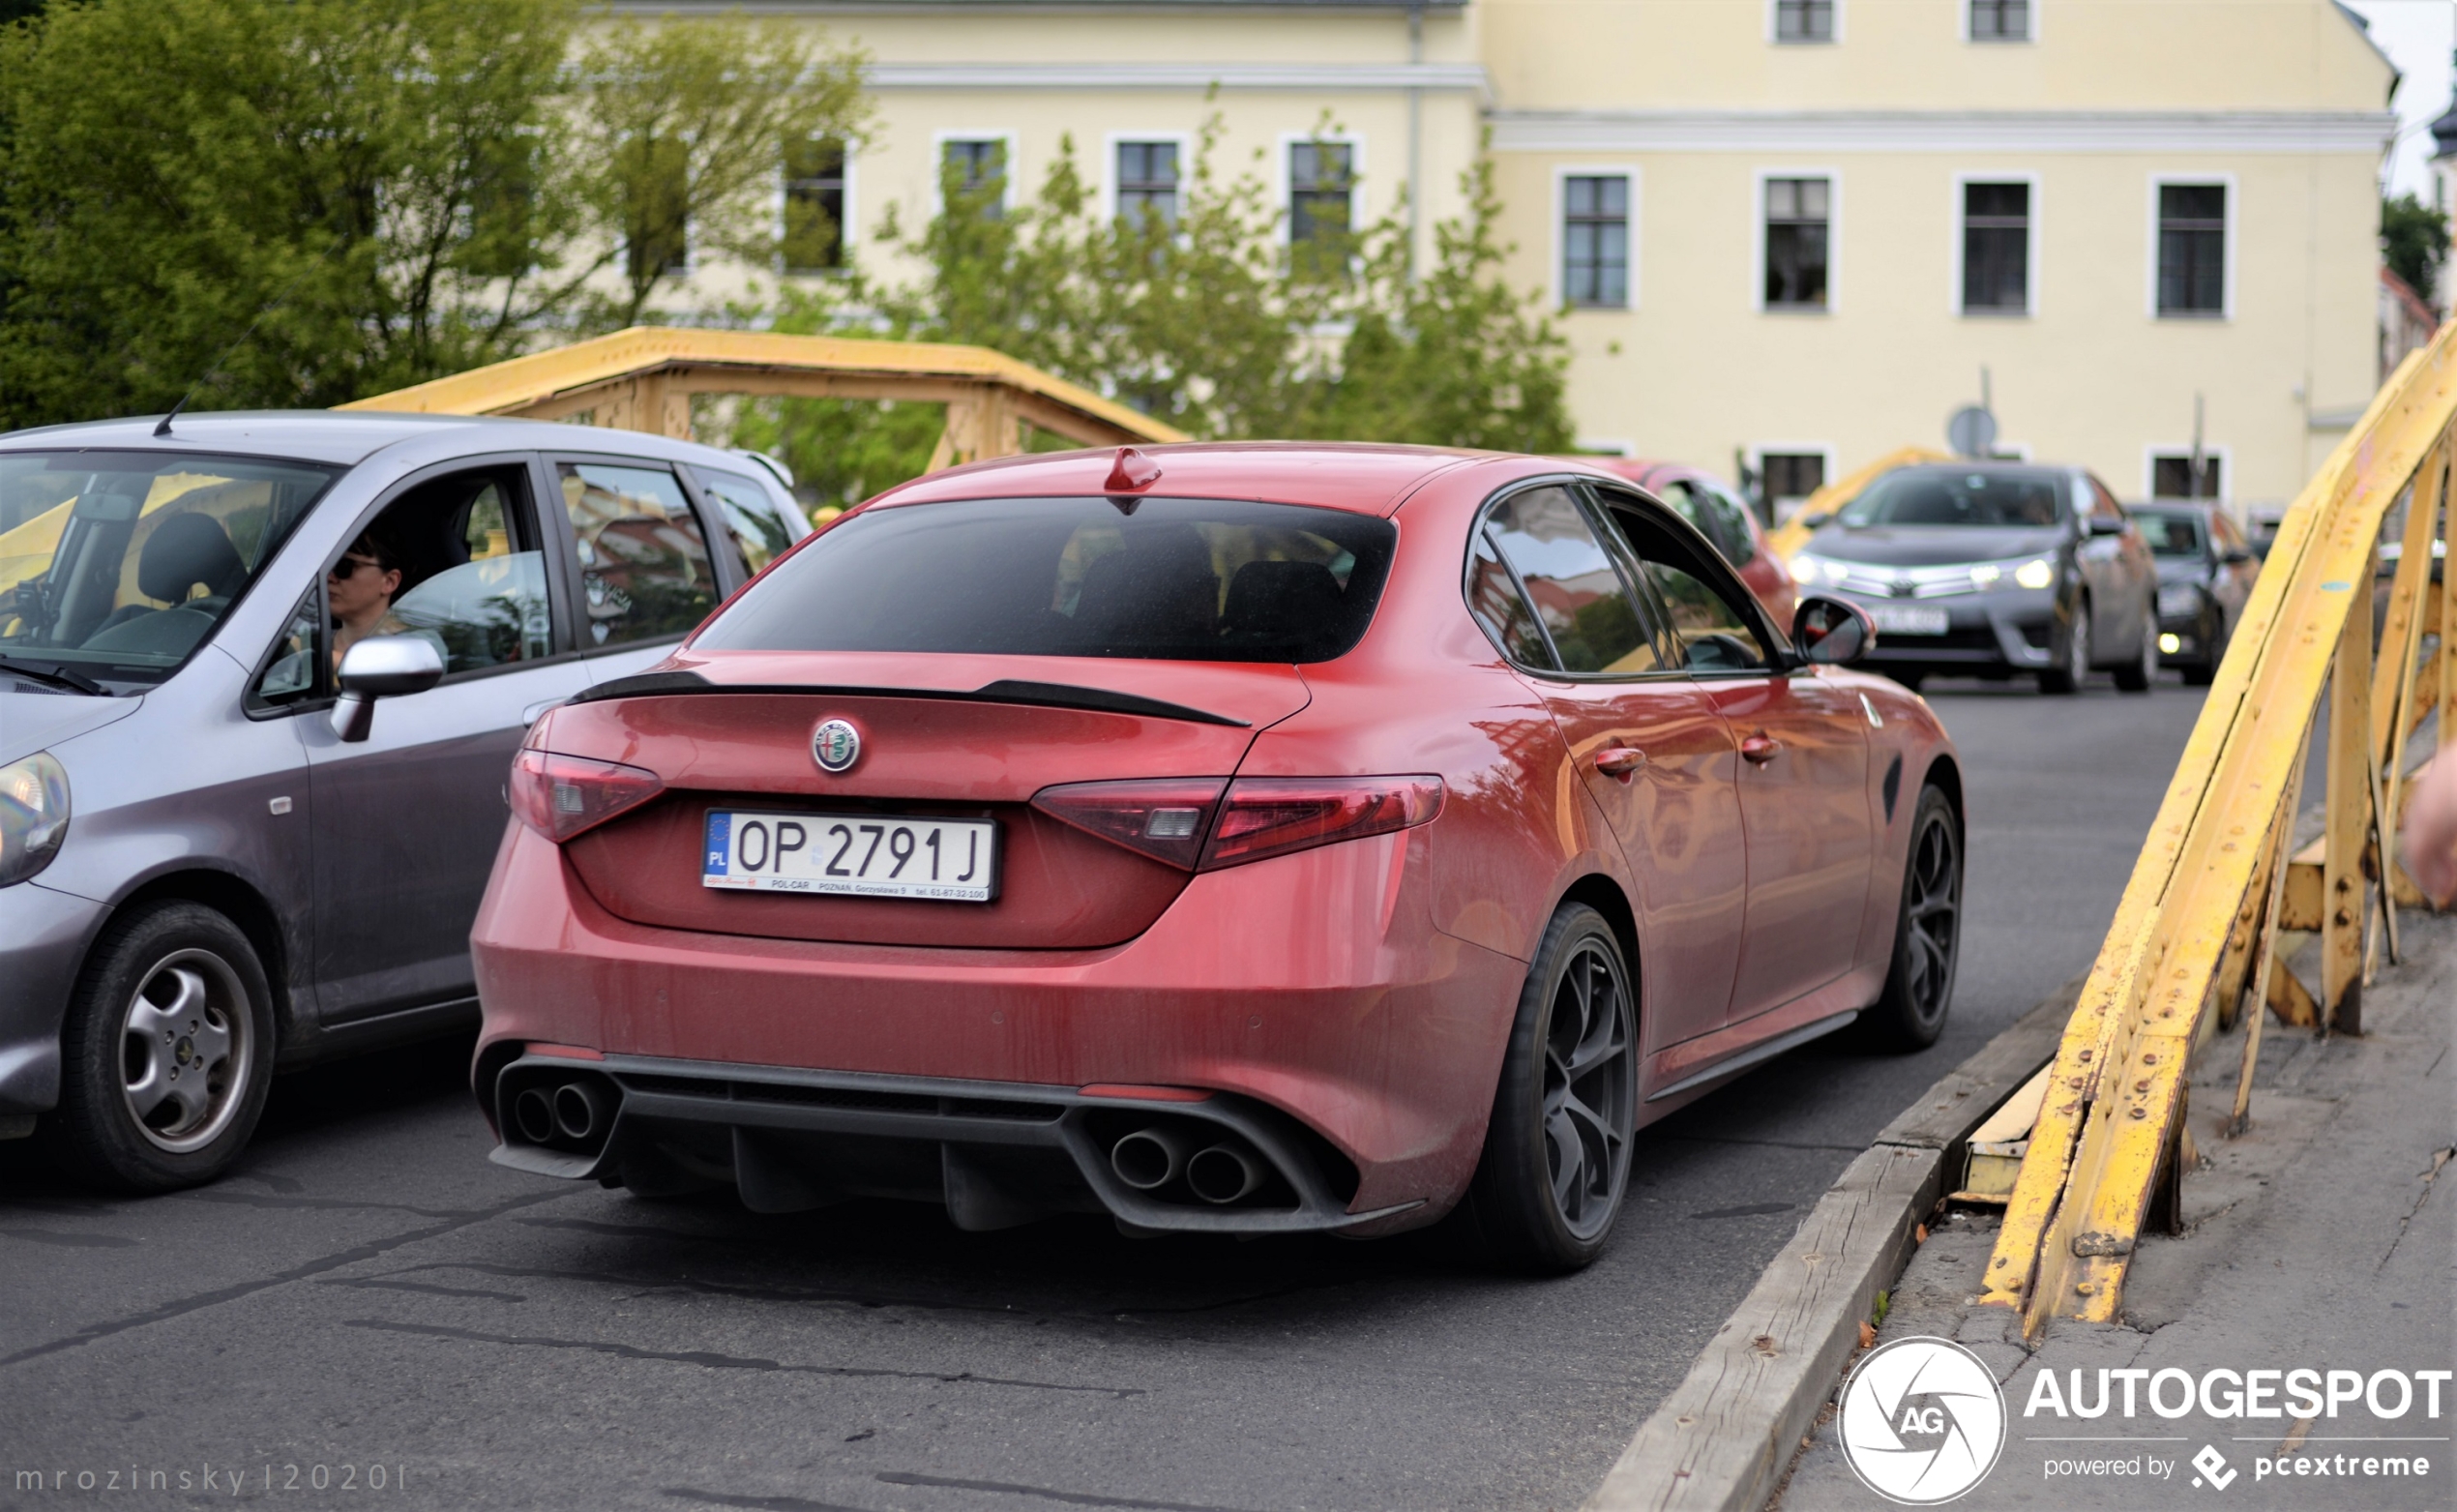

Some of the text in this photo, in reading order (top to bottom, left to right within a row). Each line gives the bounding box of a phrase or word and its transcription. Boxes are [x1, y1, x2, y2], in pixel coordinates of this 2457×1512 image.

[709, 851, 725, 866] PL
[738, 820, 977, 882] OP 2791J
[771, 879, 810, 889] POL-CAR
